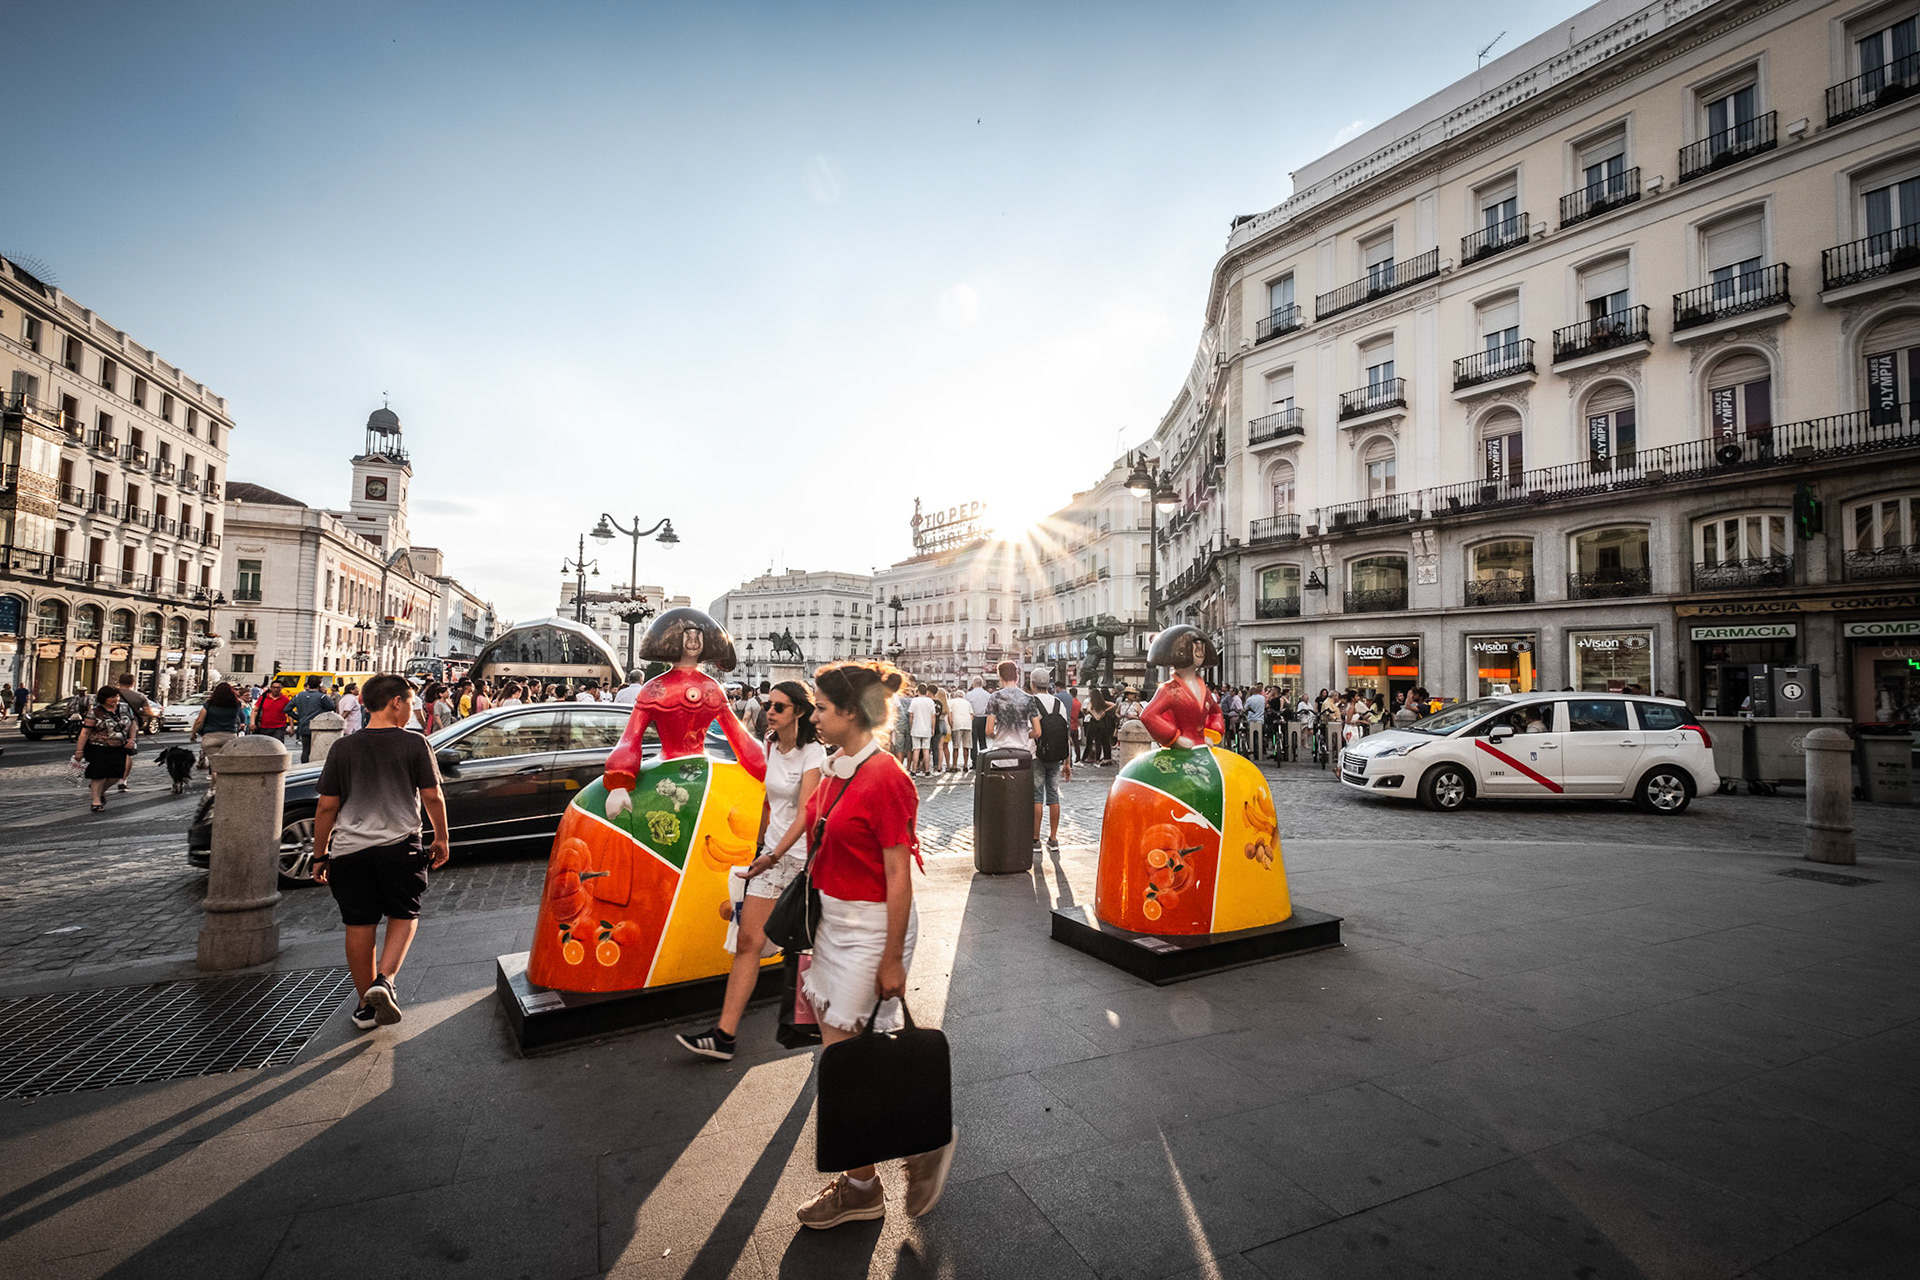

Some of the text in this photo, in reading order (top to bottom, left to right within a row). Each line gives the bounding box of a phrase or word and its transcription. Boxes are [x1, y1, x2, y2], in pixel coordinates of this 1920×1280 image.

[1871, 358, 1879, 385] VIAJES
[1879, 355, 1894, 410] OLYMPIA
[1722, 390, 1733, 439] OLYMPIA
[1597, 417, 1606, 461] OLYMPIA
[925, 511, 945, 529] TIO
[1699, 601, 1800, 614] FARMACIA
[1694, 626, 1791, 638] FARMACIA
[1882, 648, 1920, 658] CAUD
